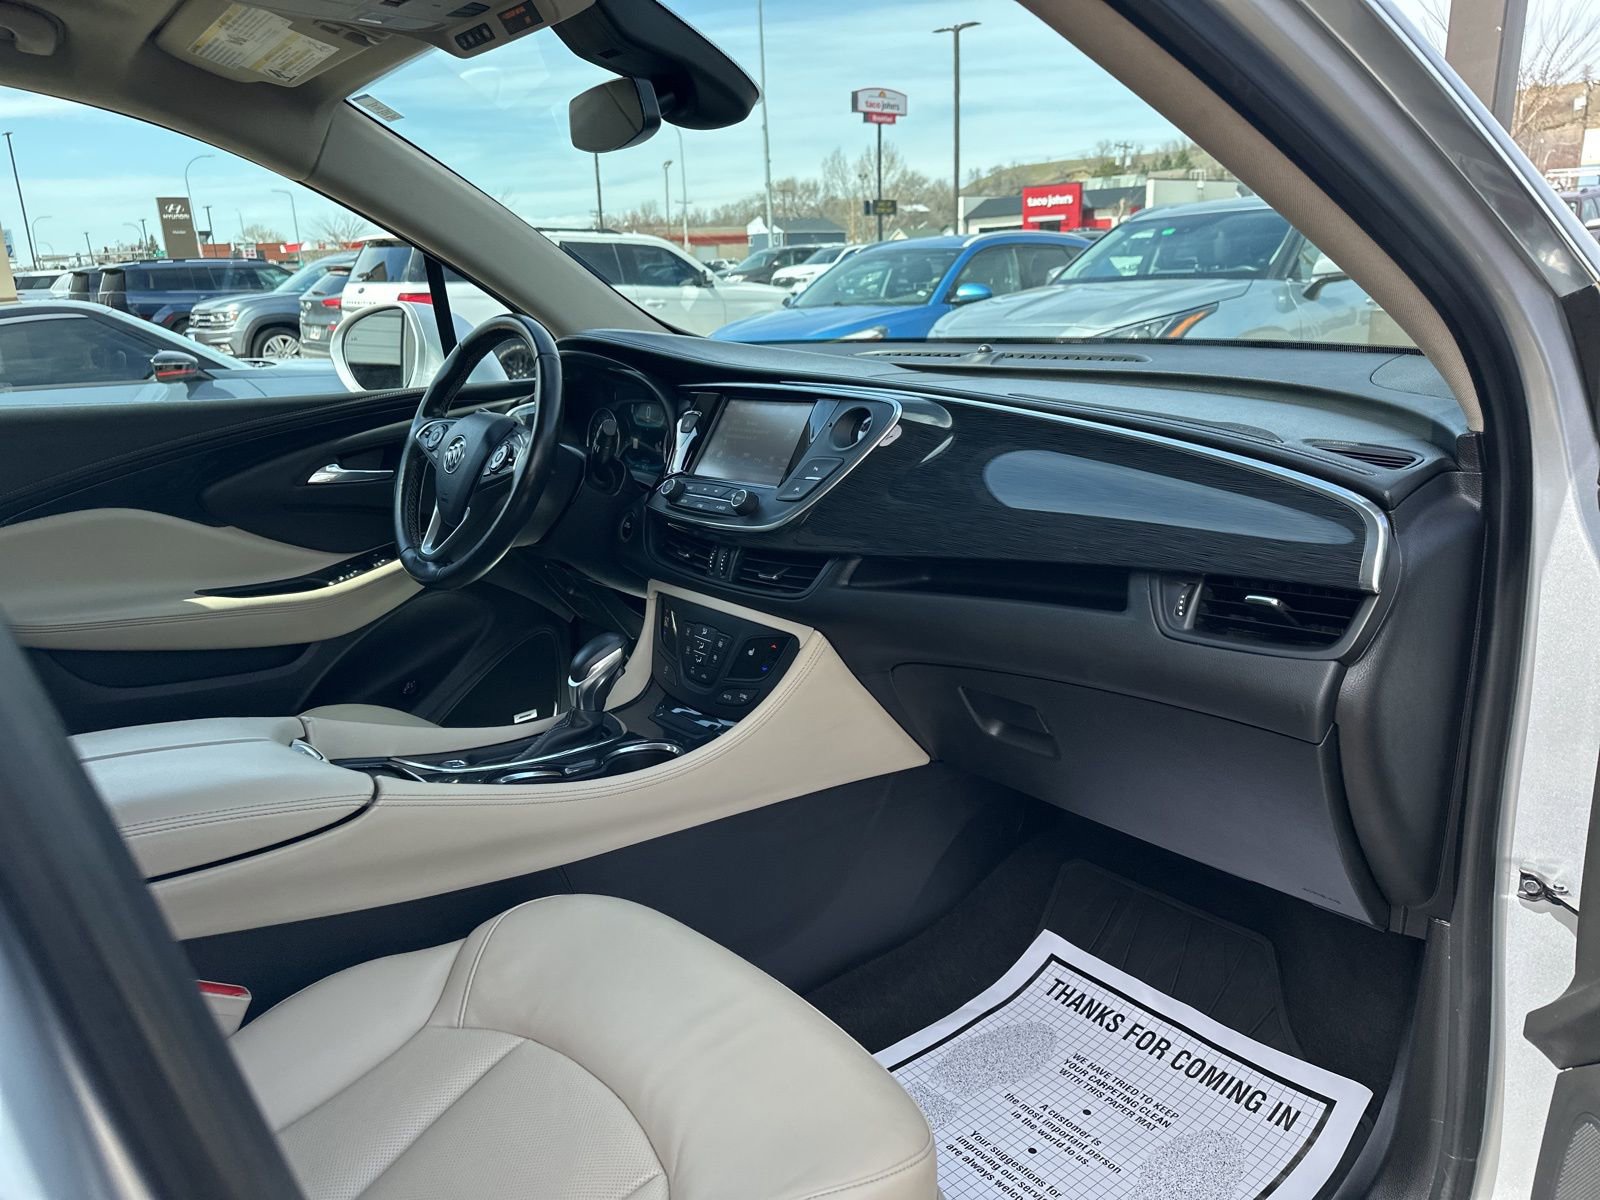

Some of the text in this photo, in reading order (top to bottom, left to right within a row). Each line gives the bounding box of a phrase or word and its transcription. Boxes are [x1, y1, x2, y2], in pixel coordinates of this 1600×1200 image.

[865, 100, 881, 110] taco
[1027, 196, 1048, 207] taco
[1046, 978, 1301, 1132] THANKS FOR COMING IN
[1073, 1053, 1180, 1119] WE HAVE TRIED TO KEEP
[1039, 1103, 1102, 1147] A customer is
[1059, 1067, 1159, 1132] WITH THIS PAPER MAT
[1063, 1058, 1172, 1128] YOUR CARPETING CLEAN
[946, 1143, 963, 1157] are
[962, 1155, 995, 1181] always
[970, 1130, 1063, 1198] Your suggestions for
[1004, 1093, 1122, 1174] the most important person
[1011, 1110, 1090, 1167] in the world to us.
[955, 1135, 1047, 1200] improving our servi
